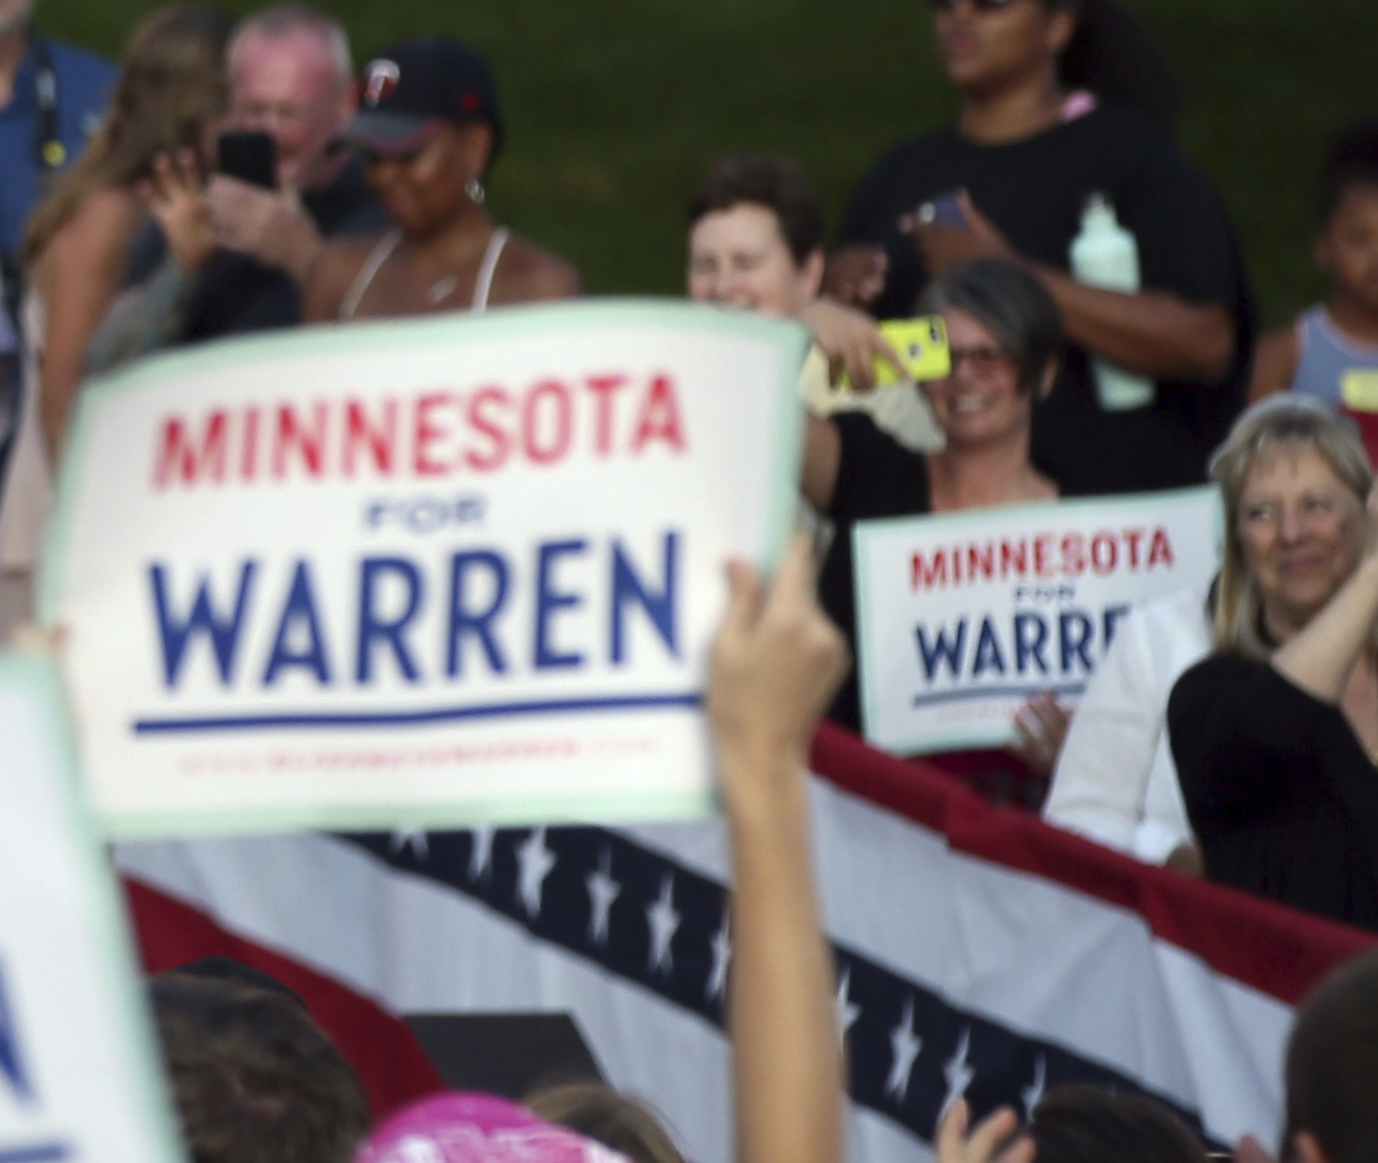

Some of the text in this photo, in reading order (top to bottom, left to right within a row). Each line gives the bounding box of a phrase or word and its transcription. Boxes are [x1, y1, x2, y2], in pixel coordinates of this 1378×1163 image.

[152, 371, 687, 494] MINNESOTA
[363, 492, 486, 532] FOR
[910, 527, 1174, 593] MINNESOTA
[147, 528, 684, 693] WARREN
